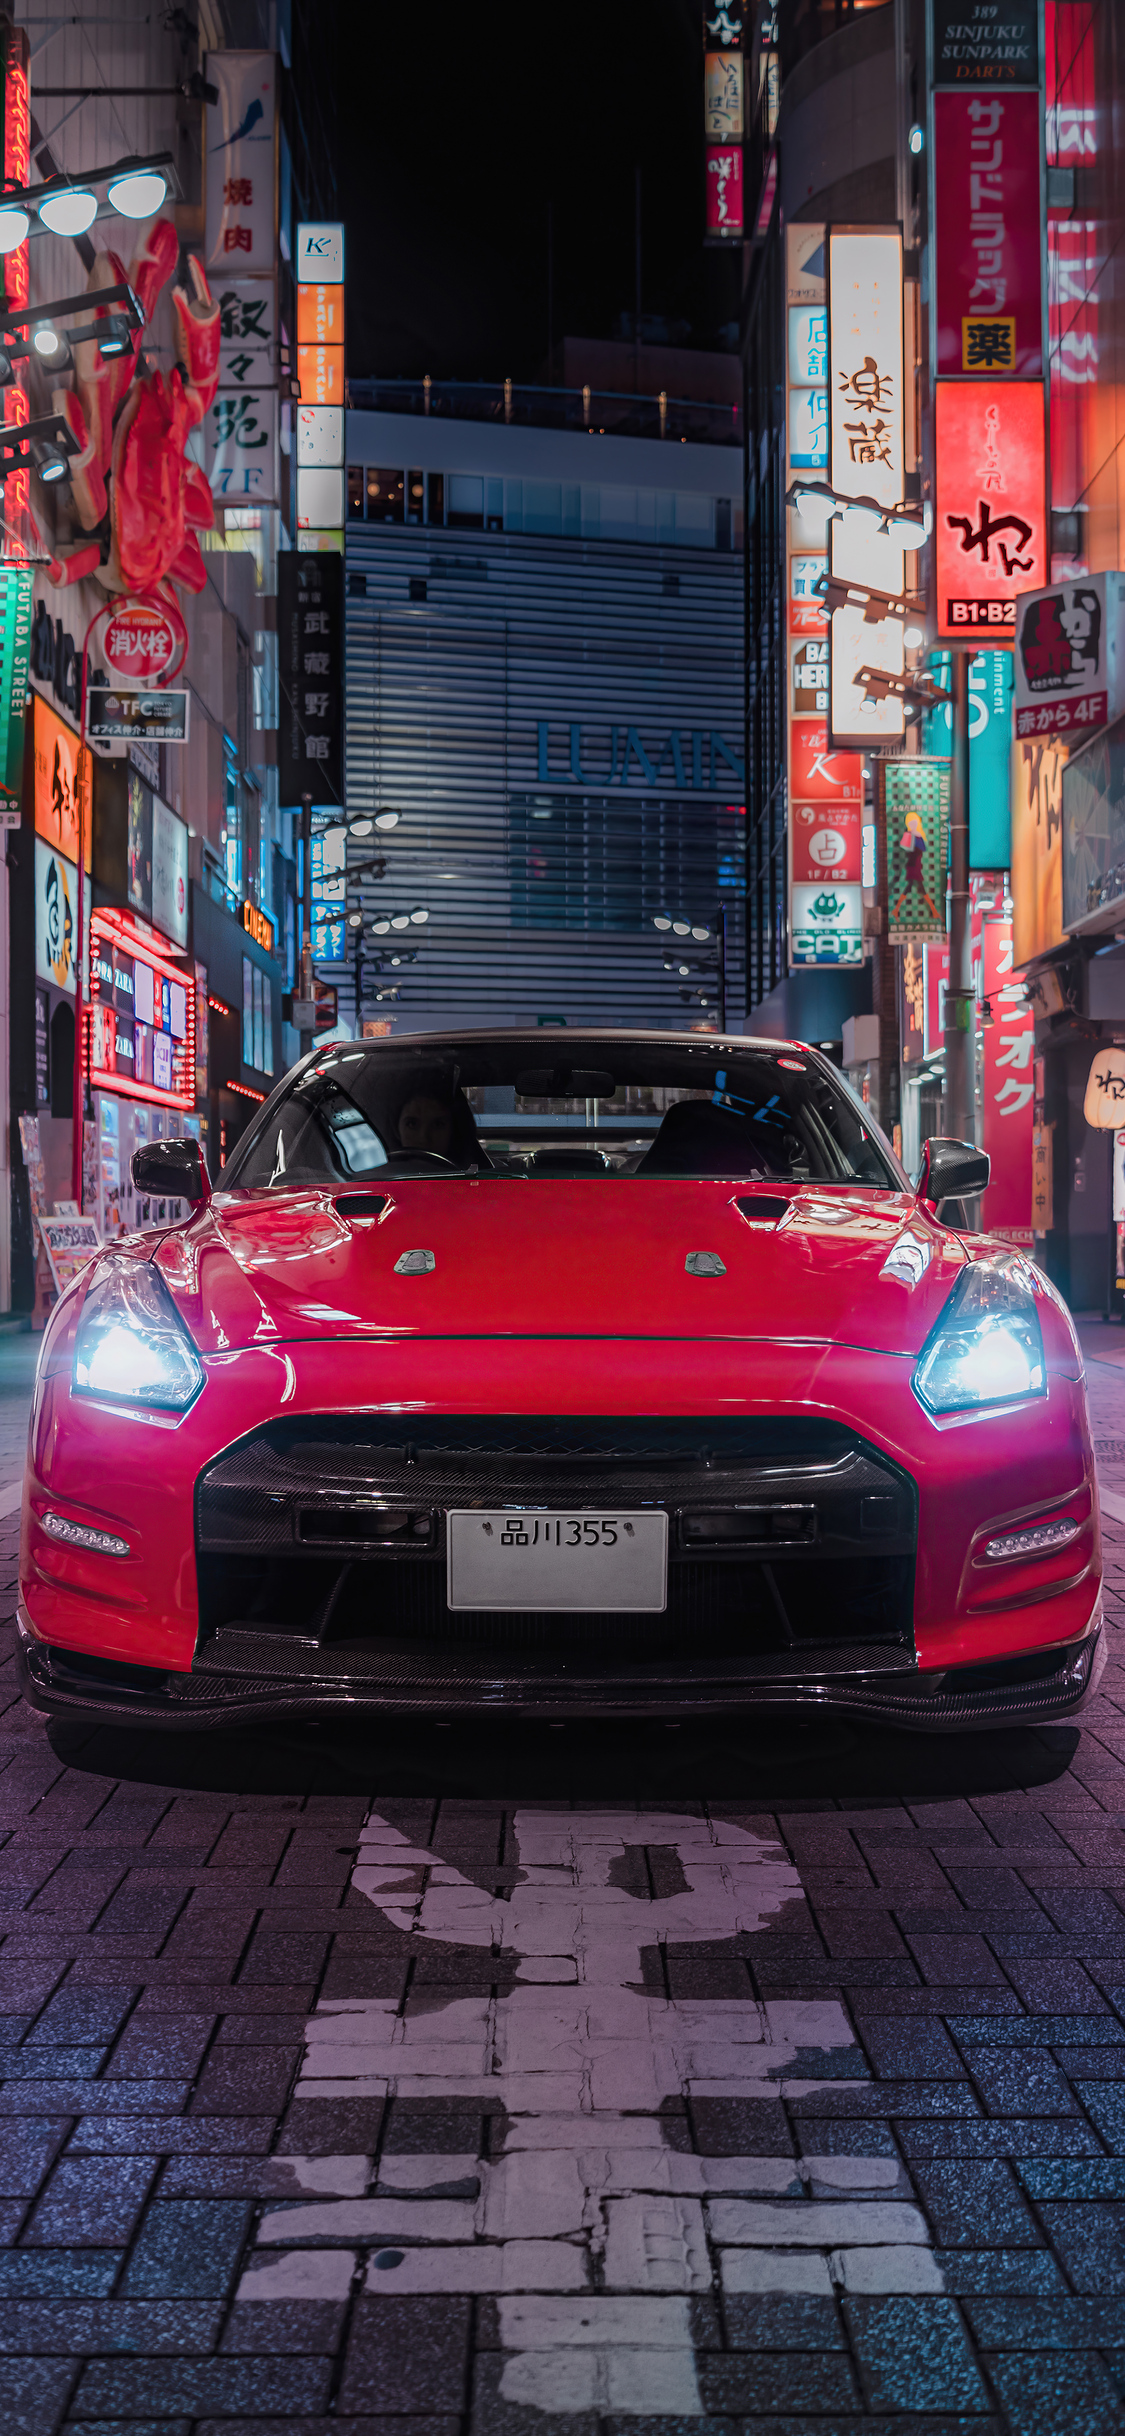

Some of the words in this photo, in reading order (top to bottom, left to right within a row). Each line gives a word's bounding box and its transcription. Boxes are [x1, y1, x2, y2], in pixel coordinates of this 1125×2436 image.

[971, 5, 998, 20] 389
[945, 24, 1026, 43] SINJUKU
[941, 44, 1030, 60] SUNPARK
[955, 65, 1016, 79] DARTS
[222, 177, 254, 254] 焼肉
[967, 100, 1006, 315] サンドラッグ
[966, 323, 1012, 367] 薬
[212, 291, 273, 450] 叙々苑
[217, 468, 265, 494] 7F
[946, 499, 1035, 577] わん
[15, 581, 32, 647] FUTABA
[115, 616, 131, 626] FIRE
[132, 617, 163, 627] HYDRANT
[109, 629, 168, 658] 消火栓
[11, 656, 28, 719] STREET
[120, 699, 153, 717] TFC
[1016, 704, 1071, 735] 赤から
[1074, 697, 1103, 723] 4F
[806, 753, 849, 786] K
[939, 775, 949, 820] FUTABA
[817, 833, 837, 861] 占
[939, 826, 948, 870] STREET
[807, 869, 822, 880] 1F
[831, 869, 848, 880] B2
[792, 934, 862, 955] CAT
[500, 1518, 618, 1546] 品川355
